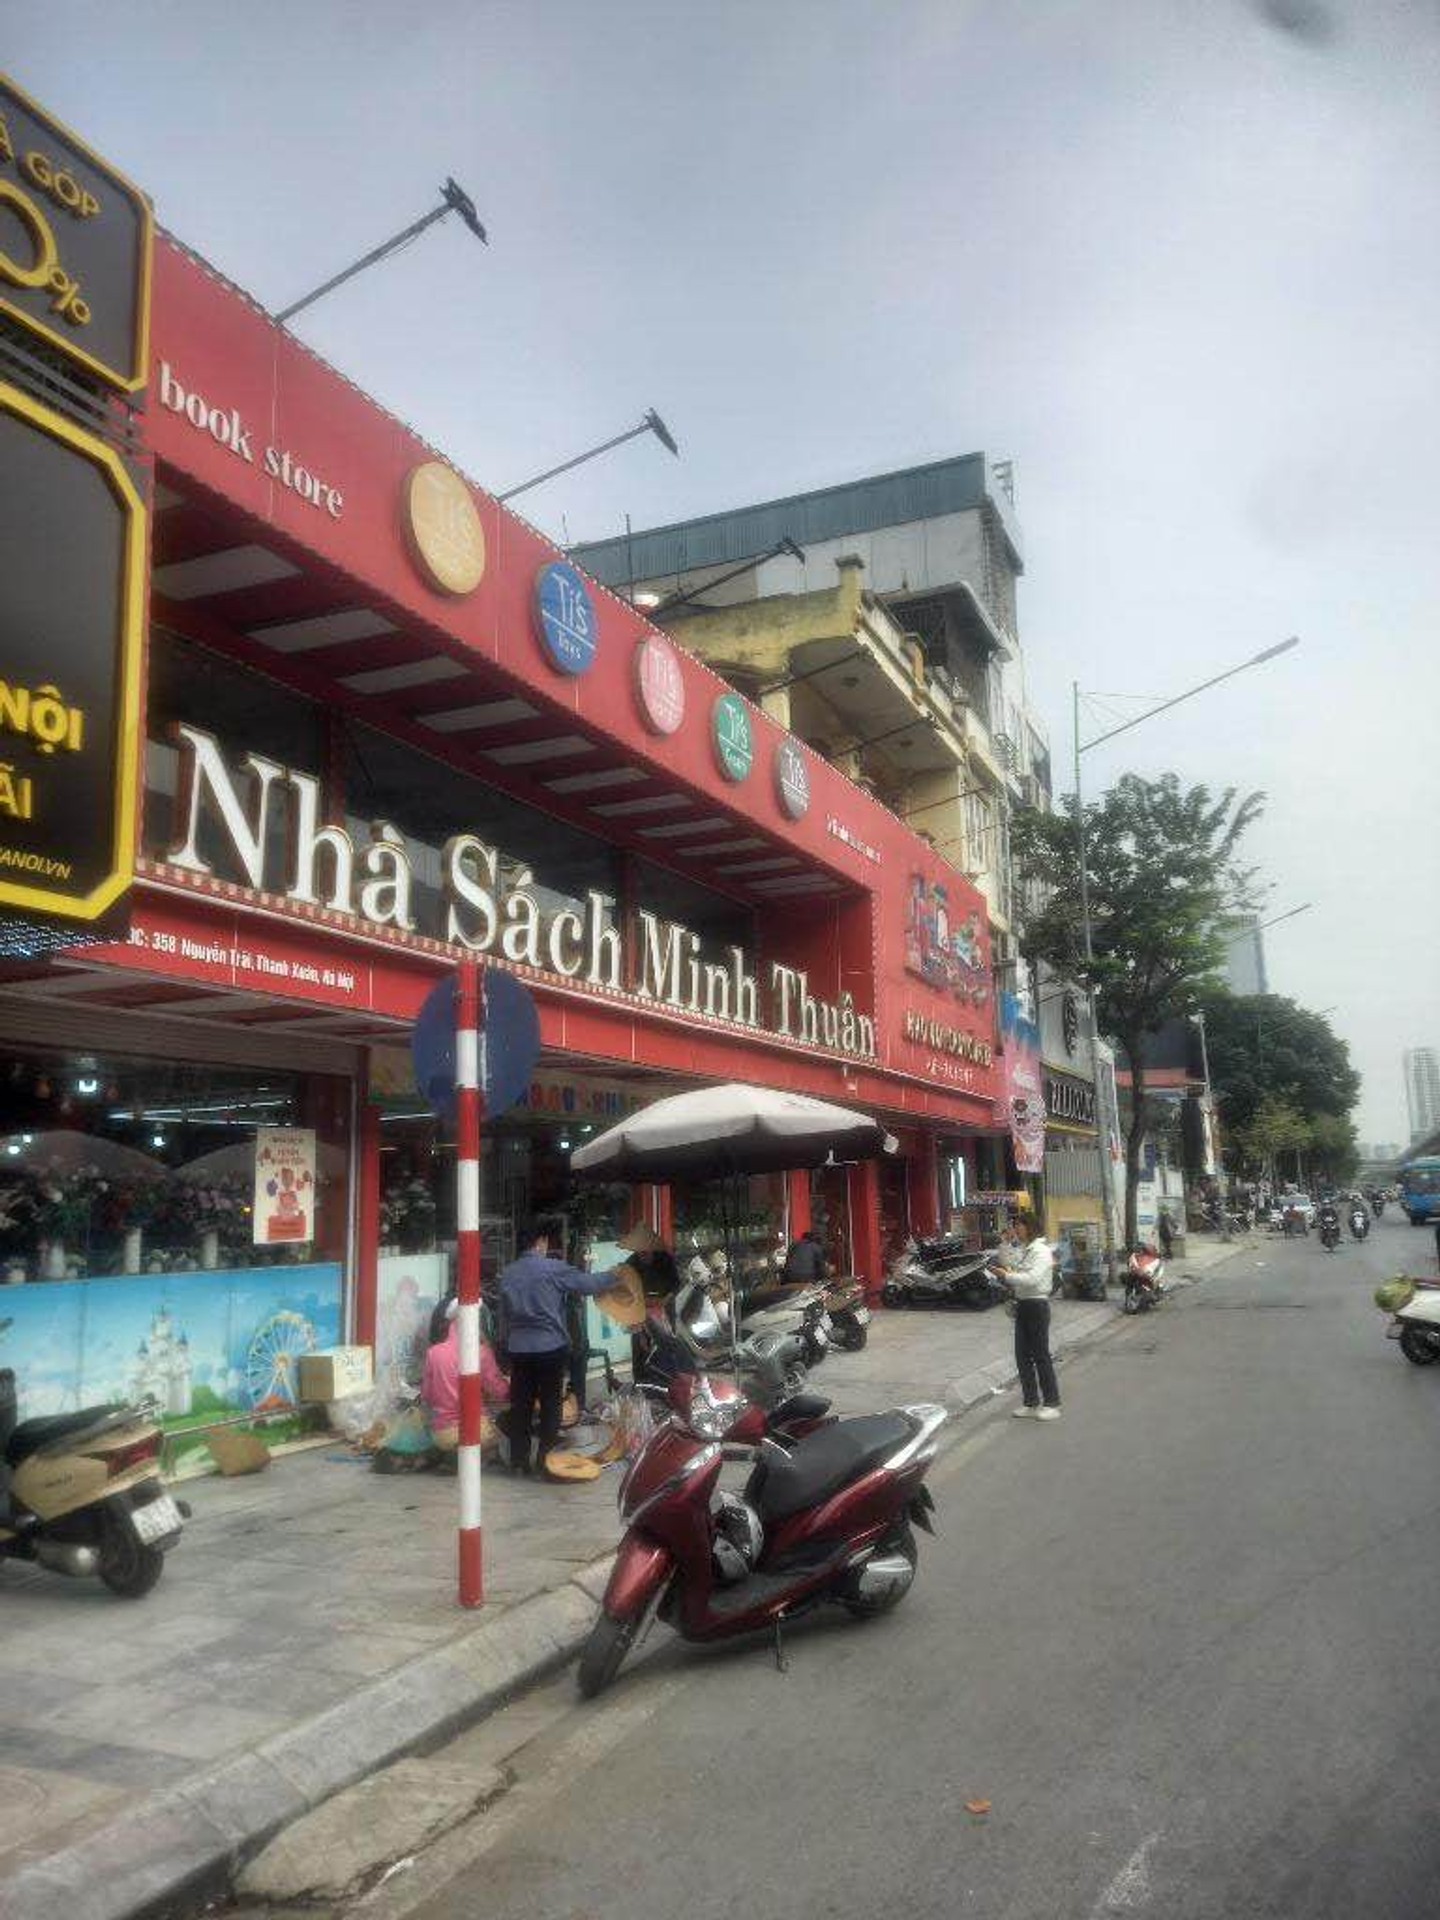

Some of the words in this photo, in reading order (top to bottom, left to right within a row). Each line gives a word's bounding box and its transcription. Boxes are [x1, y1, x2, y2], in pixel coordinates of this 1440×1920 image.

[159, 359, 253, 465] book
[264, 446, 344, 519] store
[151, 931, 176, 954] 358
[166, 721, 417, 932] Nhà
[444, 833, 622, 991] Sách
[638, 907, 760, 1029] Minh
